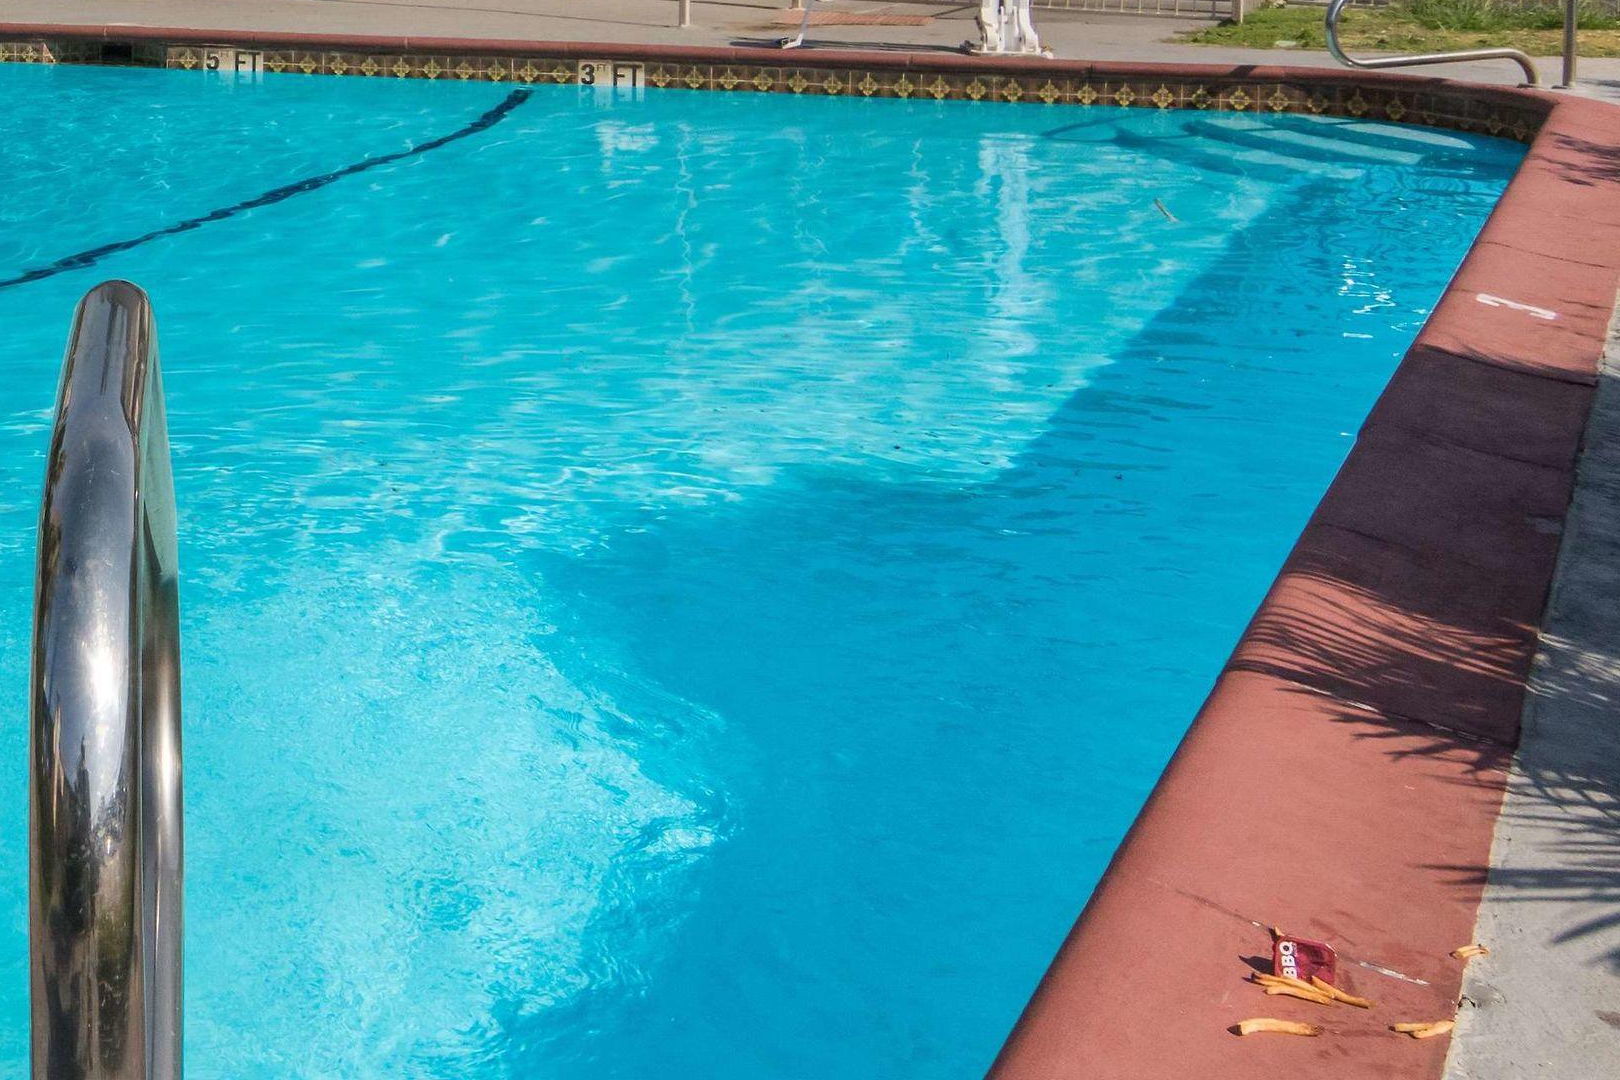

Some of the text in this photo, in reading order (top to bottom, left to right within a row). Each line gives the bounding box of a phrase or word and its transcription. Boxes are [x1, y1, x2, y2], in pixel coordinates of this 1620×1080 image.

[206, 53, 220, 70] 5
[235, 51, 261, 71] FT
[580, 63, 595, 85] 3
[612, 63, 643, 87] FT
[1279, 940, 1298, 979] BBQ
